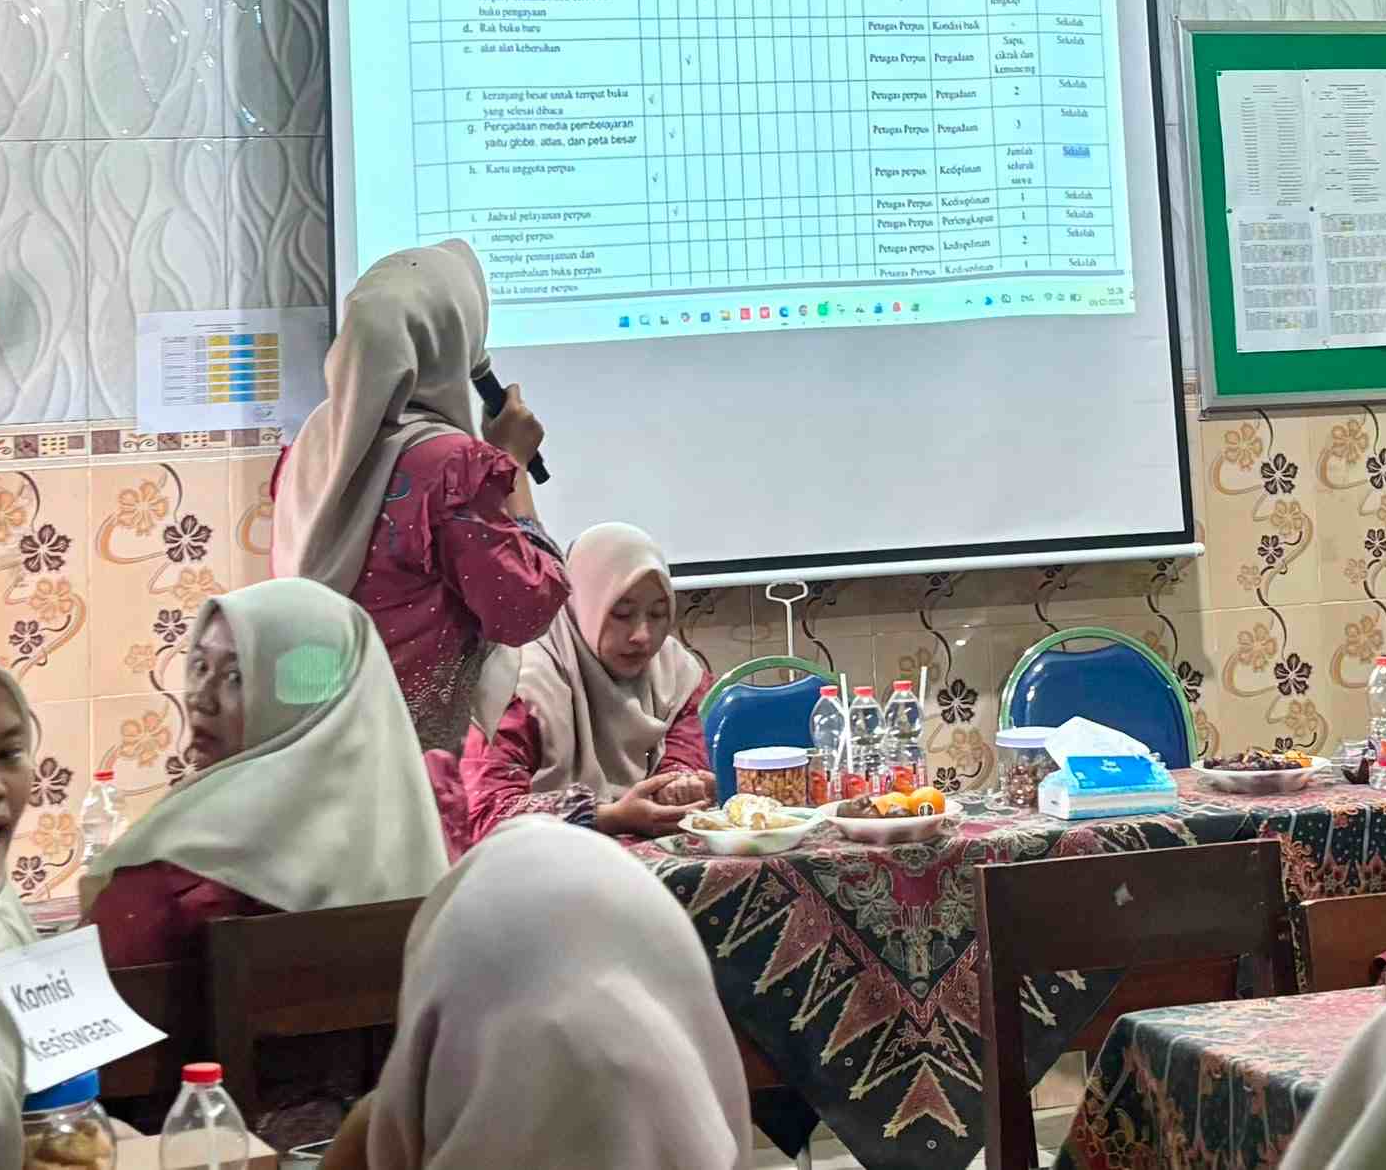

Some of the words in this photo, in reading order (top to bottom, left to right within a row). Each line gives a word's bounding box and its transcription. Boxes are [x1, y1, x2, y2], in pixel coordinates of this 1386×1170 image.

[479, 8, 500, 17] buku
[868, 21, 897, 32] Petugas
[900, 22, 925, 32] Perpus
[1056, 18, 1084, 27] Sekolah
[480, 23, 496, 33] Rak
[499, 23, 520, 33] buku
[522, 23, 540, 33] baru
[1056, 36, 1085, 45] Sekolah
[481, 44, 496, 52] alat
[499, 44, 514, 52] alat
[516, 43, 560, 53] kebersihan
[869, 54, 899, 64] Petugas
[901, 54, 926, 64] Perpus
[1020, 50, 1034, 59] dan
[1059, 79, 1087, 89] Sekolah
[482, 91, 524, 104] keranjang
[526, 91, 547, 100] besar
[550, 90, 573, 100] untuk
[576, 90, 605, 102] tempat
[607, 89, 628, 98] buku
[871, 90, 899, 101] Petugas
[902, 91, 927, 101] perpus
[484, 108, 504, 117] yang
[507, 107, 534, 116] selesai
[536, 106, 563, 115] dibaca
[1061, 108, 1089, 118] Sekolah
[484, 121, 537, 133] Pengadaan
[539, 121, 568, 131] media
[570, 119, 633, 131] pembelajaran
[873, 124, 902, 135] Petugas
[904, 125, 929, 135] Perpus
[485, 137, 507, 149] yaitu
[568, 136, 585, 146] dan
[587, 136, 609, 147] peta
[611, 135, 637, 144] besar
[1007, 147, 1033, 156] Jumlah
[1063, 146, 1090, 156] Sekolah
[486, 164, 510, 174] Kartu
[512, 165, 545, 175] anggota
[547, 165, 575, 175] perpus
[901, 167, 927, 177] perpus
[1065, 190, 1093, 199] Sekolah
[877, 199, 905, 209] Petugas
[907, 199, 933, 209] Perpus
[488, 211, 516, 222] Jadwal
[563, 212, 591, 222] perpus
[1066, 210, 1094, 219] Sekolah
[877, 218, 906, 229] Petugas
[908, 218, 934, 229] Perpus
[492, 232, 523, 243] stempel
[526, 232, 553, 242] perpus
[1067, 229, 1095, 238] Sekolah
[879, 243, 907, 254] Petugas
[910, 244, 935, 254] perpus
[579, 250, 595, 260] dan
[1069, 258, 1097, 267] Sekolah
[552, 267, 571, 277] buku
[574, 266, 601, 276] perpus
[11, 969, 75, 1013] Komisi
[25, 1018, 123, 1062] Kesiswaan
